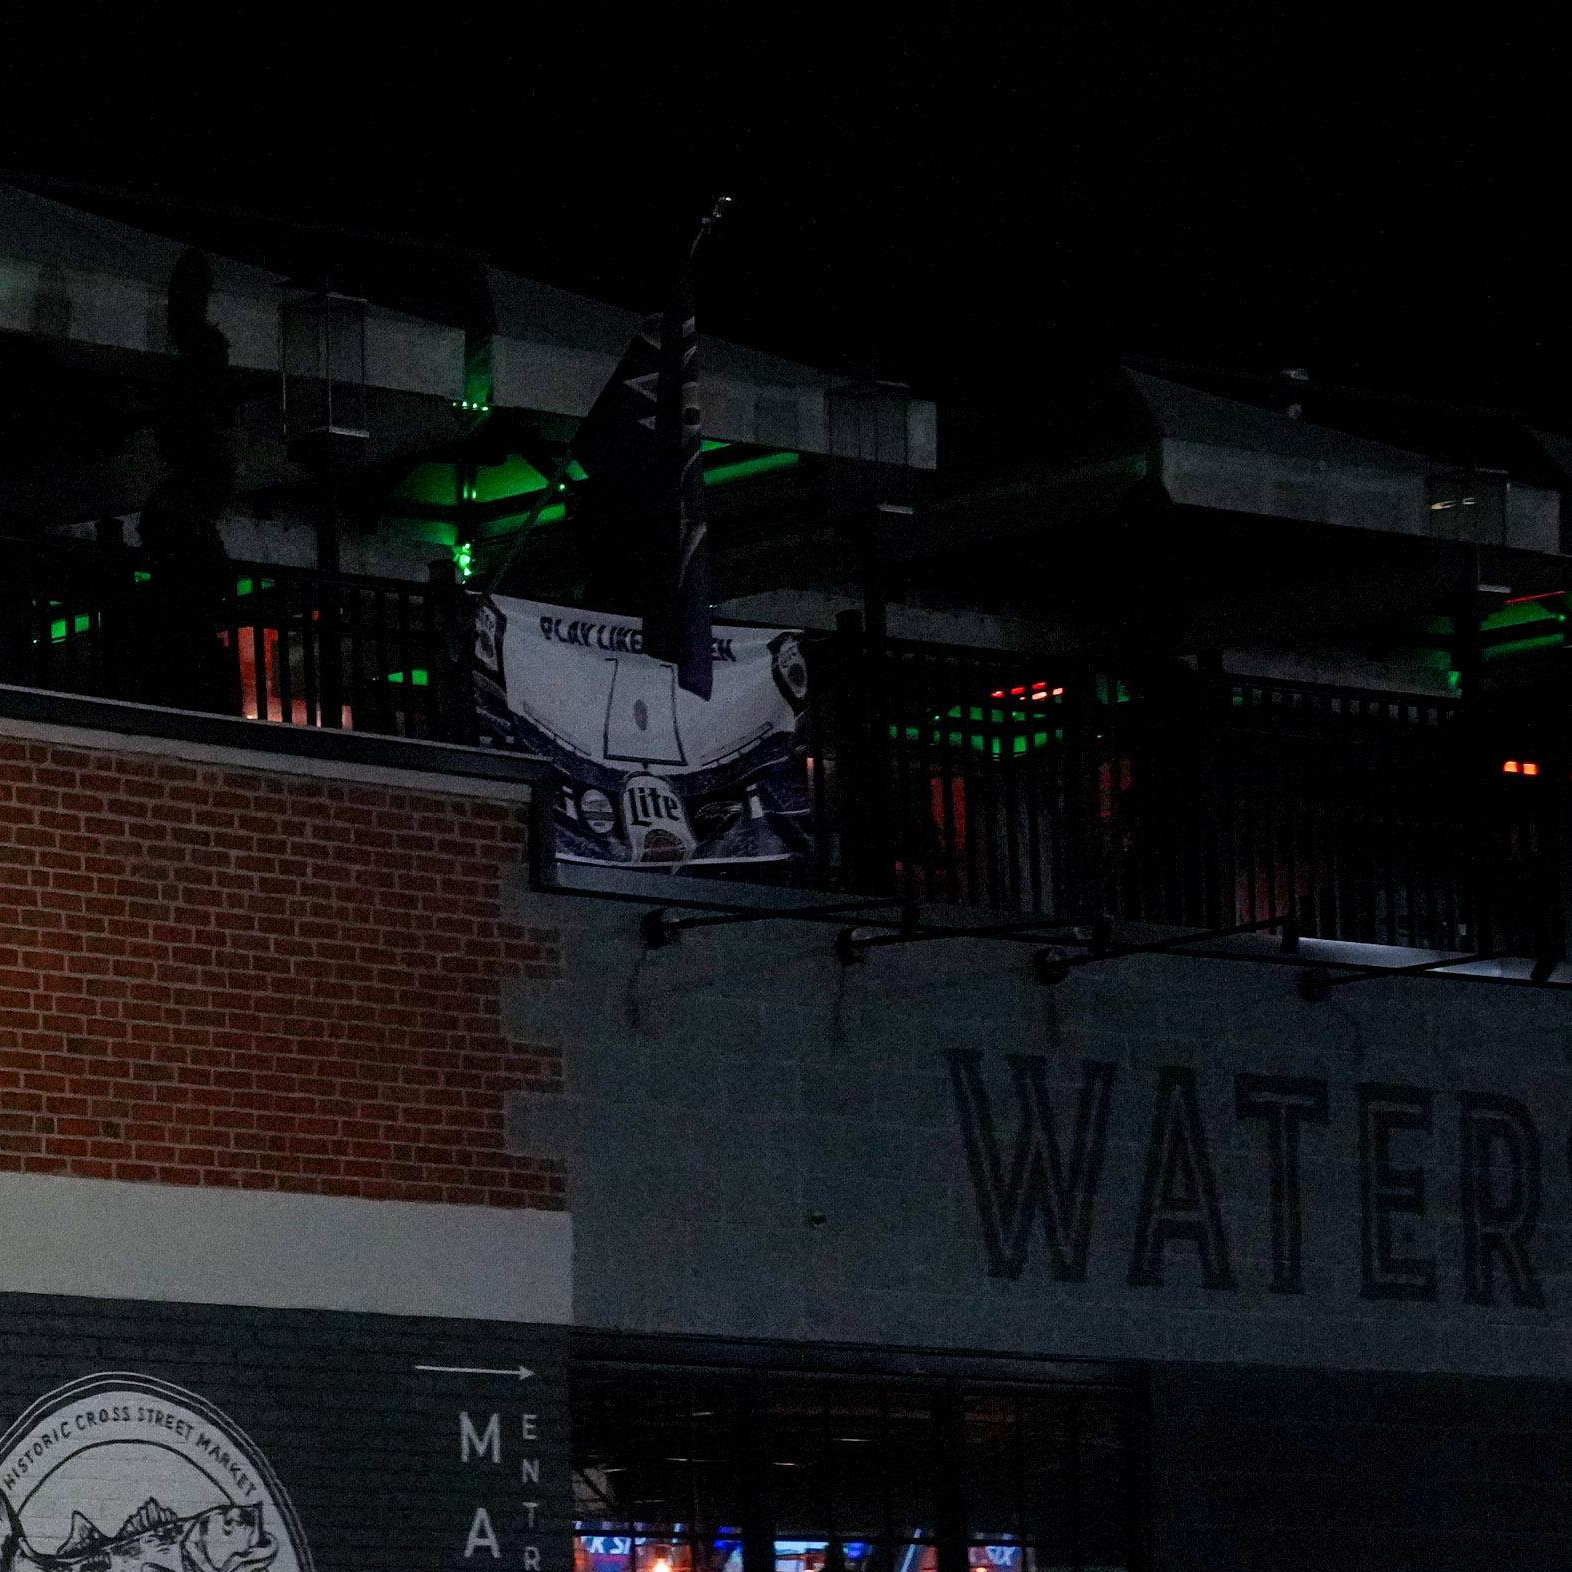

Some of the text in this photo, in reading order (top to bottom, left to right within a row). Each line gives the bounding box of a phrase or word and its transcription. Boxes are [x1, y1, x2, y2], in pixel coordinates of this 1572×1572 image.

[540, 616, 595, 647] PLAY
[627, 787, 682, 828] Lite
[942, 1048, 1572, 1309] WATER
[2, 1405, 259, 1497] HISTORIC CROSS STREET MARKET
